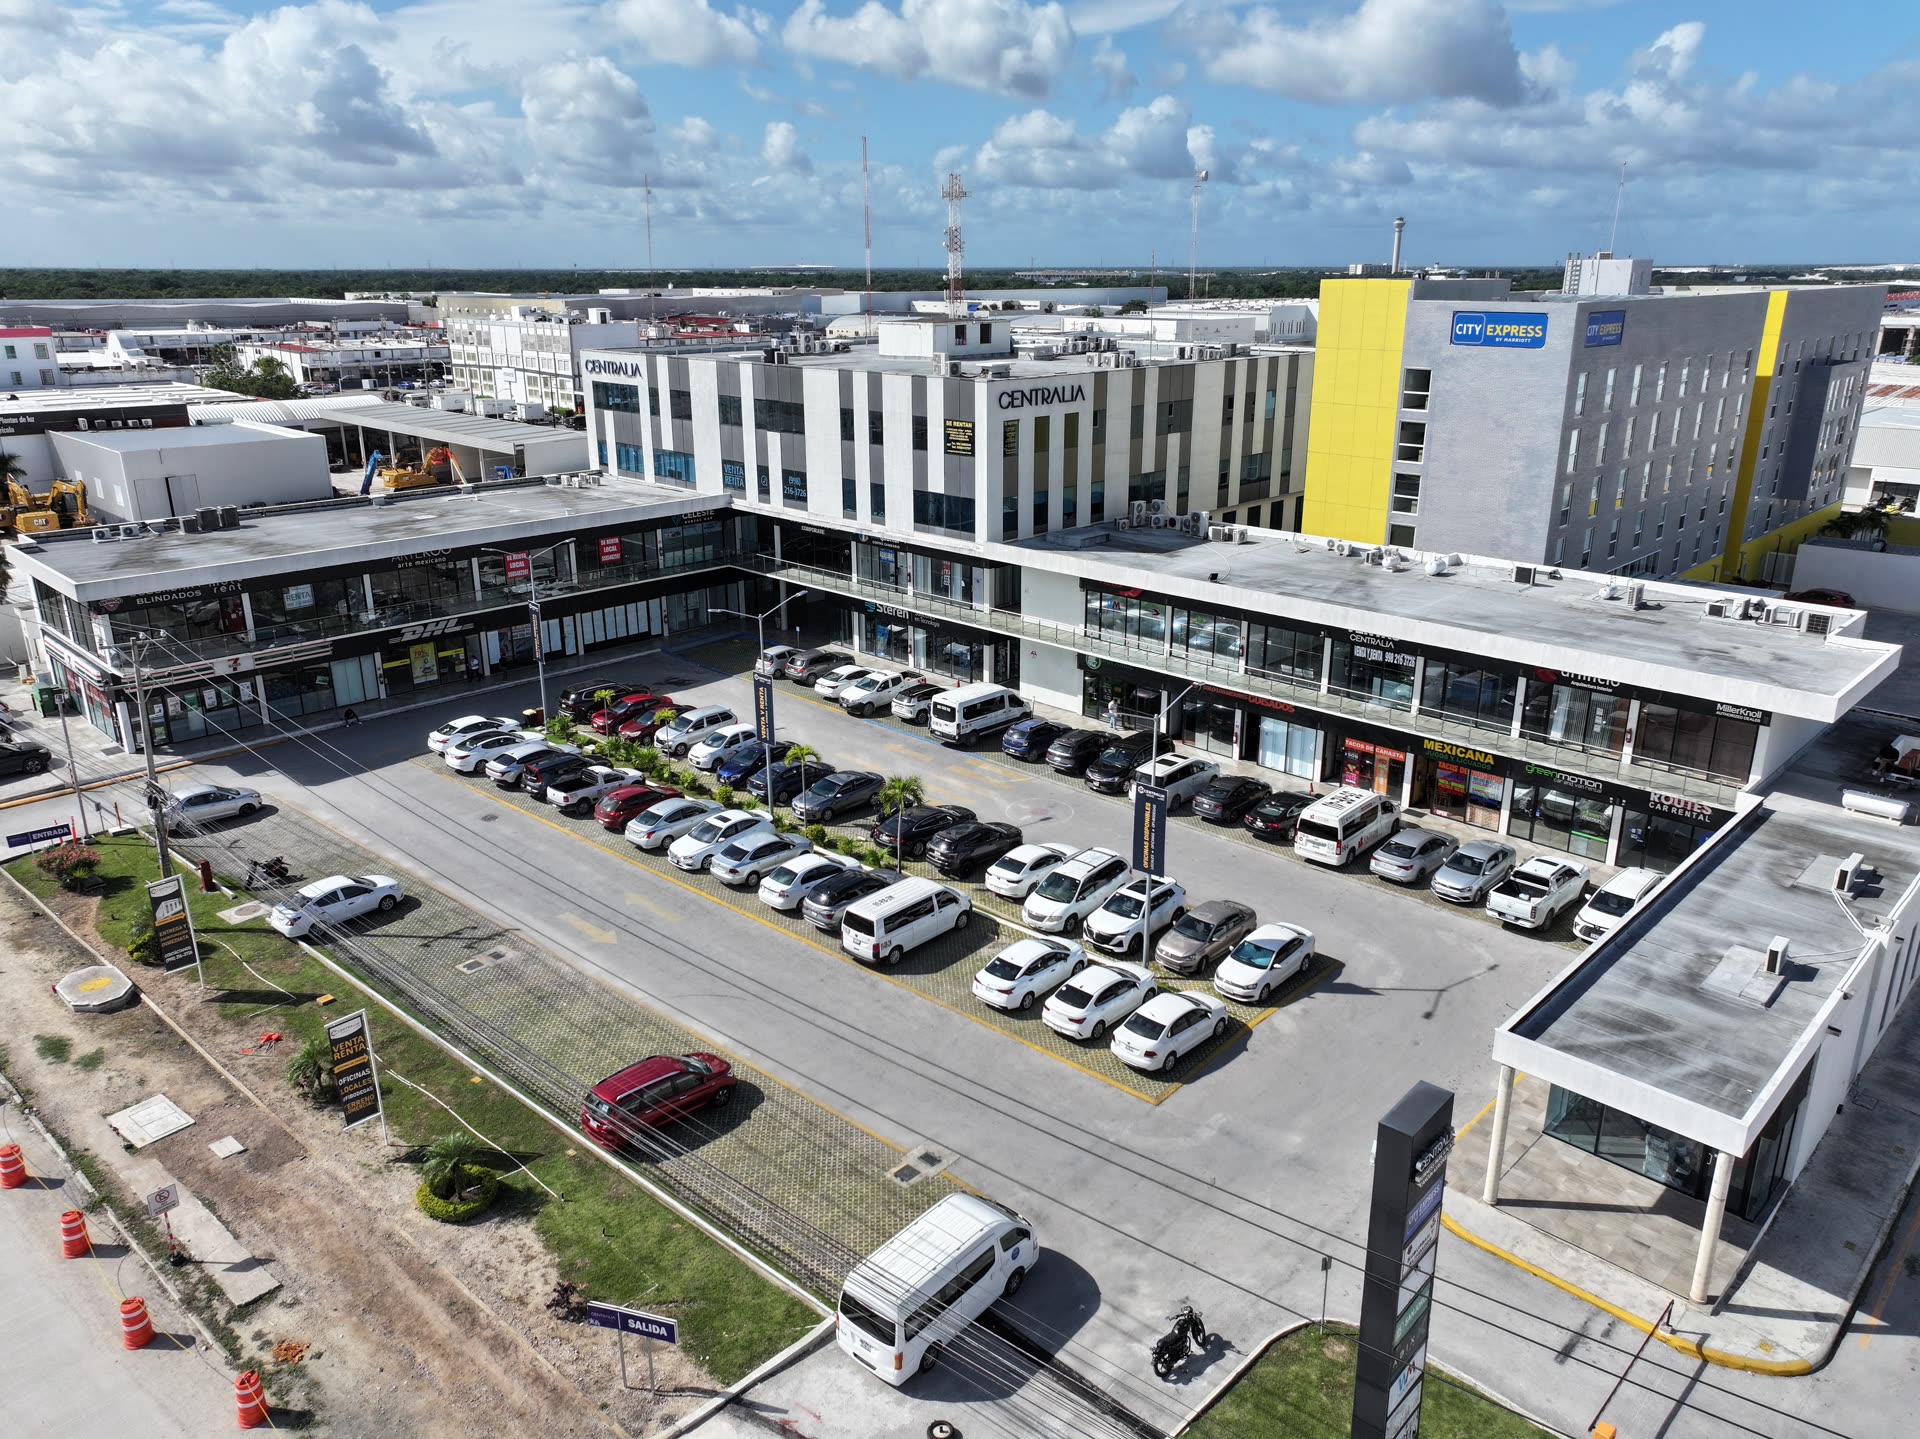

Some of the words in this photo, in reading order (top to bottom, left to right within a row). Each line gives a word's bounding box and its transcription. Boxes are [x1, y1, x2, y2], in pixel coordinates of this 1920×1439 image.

[1455, 323, 1482, 336] CITY
[1486, 324, 1543, 338] EXPRESS
[1586, 325, 1599, 337] CITY
[1600, 322, 1622, 336] EXPRESS
[585, 359, 643, 378] CENTRALIA
[999, 385, 1086, 410] CENTRALIA
[19, 415, 27, 423] de
[26, 415, 35, 423] luz
[723, 463, 744, 476] VENTA
[724, 475, 745, 488] RENTA
[784, 486, 807, 497] 216-3726
[603, 545, 617, 553] LOCAL
[414, 556, 447, 566] mexicano
[509, 561, 525, 569] LOCAL
[213, 582, 242, 594] rent
[136, 590, 202, 605] BLINDADOS
[286, 591, 311, 602] RENTA
[876, 602, 909, 620] Steren
[401, 618, 464, 642] DHL
[1350, 634, 1394, 648] CENTRALIA
[1354, 645, 1367, 658] VENTA
[1370, 648, 1383, 661] RENTA
[1384, 651, 1394, 663] 998
[1394, 653, 1403, 665] 216
[1571, 680, 1597, 690] Arquitectura
[1596, 685, 1613, 693] Interior
[1248, 696, 1295, 713] GUISADOS
[1716, 703, 1762, 719] MillerKnoll
[1715, 711, 1744, 720] AUTHORIZED
[1345, 739, 1365, 749] TACOS
[1424, 739, 1495, 765] MEXICANA
[1425, 750, 1449, 759] JUGOS
[1456, 756, 1492, 770] LICUADOS
[1438, 761, 1459, 772] TACOS
[1459, 766, 1469, 775] DE
[1585, 785, 1602, 794] rental
[1650, 792, 1712, 815] ROUTES
[1648, 802, 1669, 812] CAR
[1671, 808, 1711, 822] RENTAL
[1143, 802, 1151, 842] DISPONIBLES
[32, 827, 69, 840] ENTRADA
[160, 925, 183, 937] ENTREGA
[332, 1035, 364, 1053] VENTA
[334, 1042, 366, 1061] RENTA
[338, 1068, 370, 1086] OFICINAS
[340, 1078, 372, 1096] LOCALES
[628, 1318, 668, 1336] SALIDA
